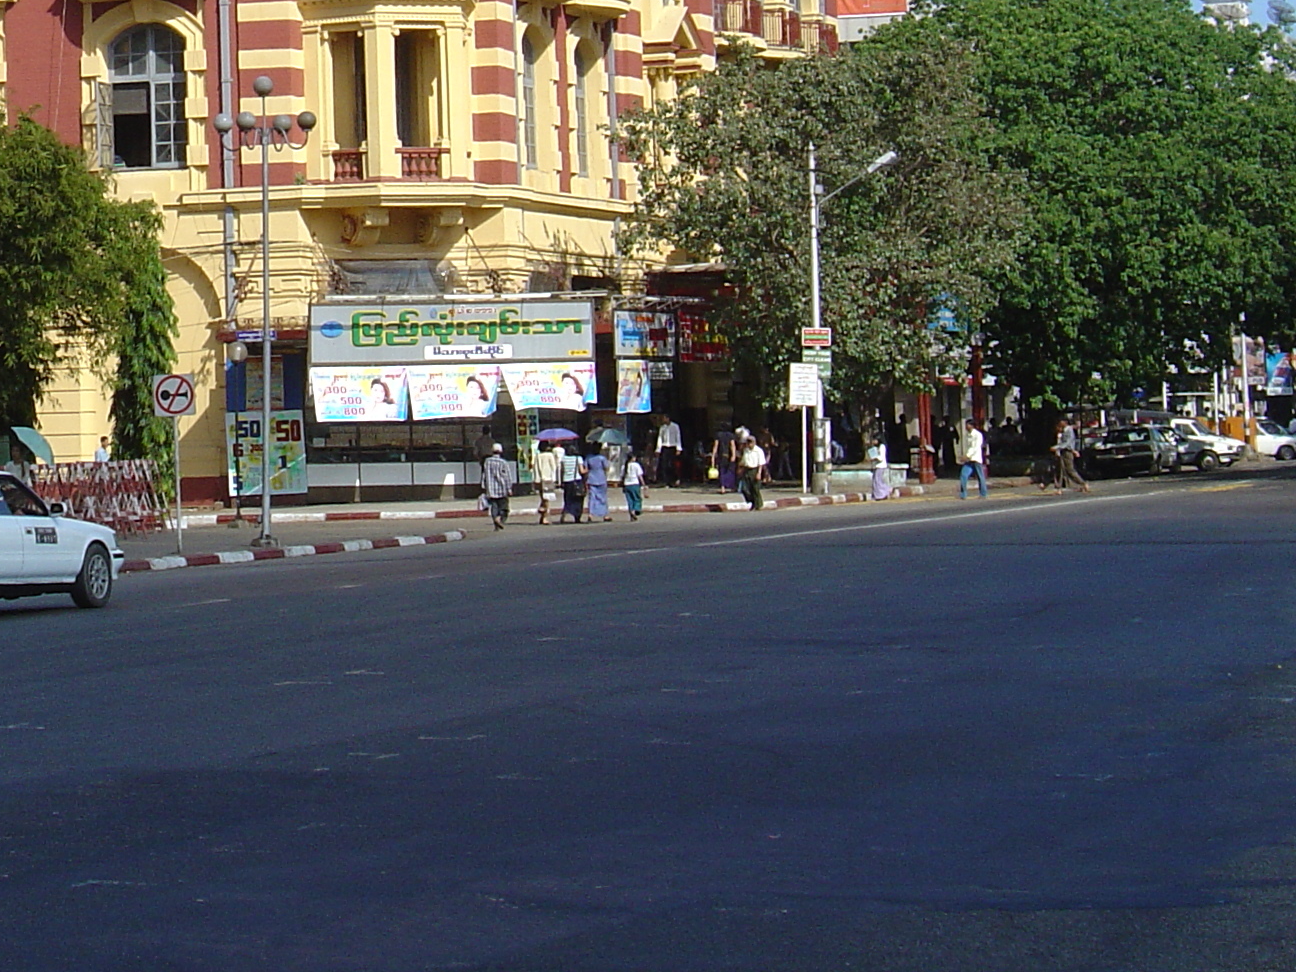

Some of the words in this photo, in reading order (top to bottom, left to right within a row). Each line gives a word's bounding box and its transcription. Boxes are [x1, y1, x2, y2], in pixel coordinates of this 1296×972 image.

[340, 396, 362, 405] 500
[344, 407, 365, 416] 800
[236, 420, 261, 438] 50
[276, 419, 302, 442] 50
